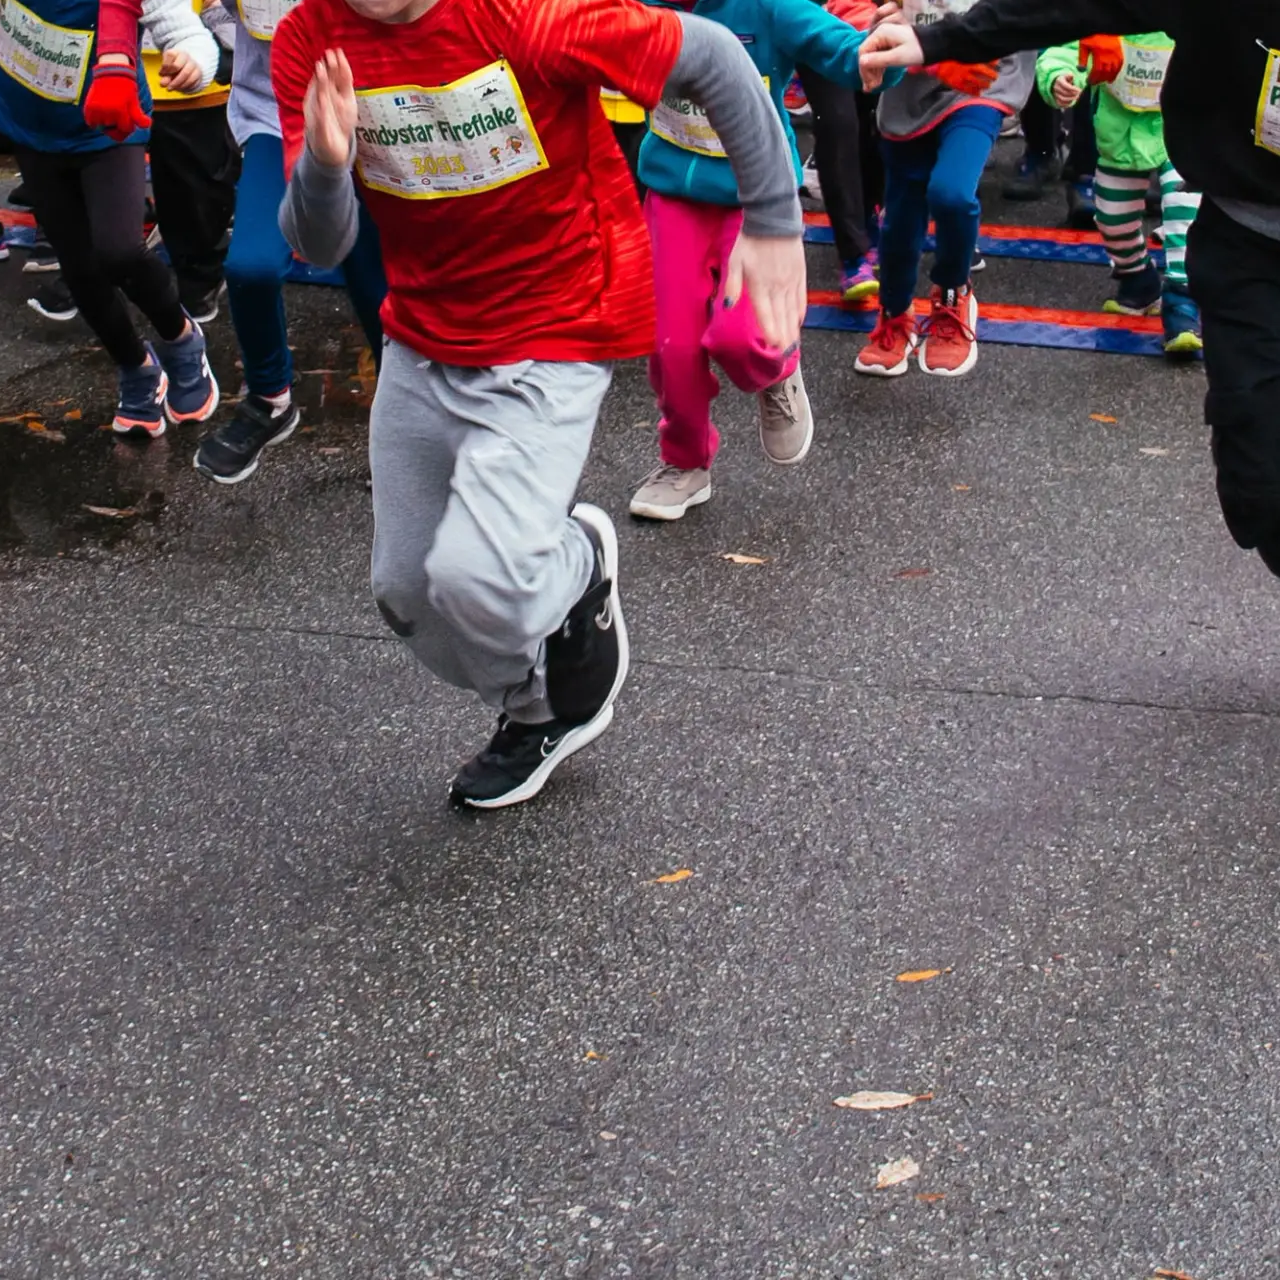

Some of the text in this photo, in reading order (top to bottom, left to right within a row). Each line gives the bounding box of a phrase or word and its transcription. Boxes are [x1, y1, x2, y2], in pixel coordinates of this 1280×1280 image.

[32, 41, 82, 69] Snowballs
[1126, 63, 1163, 81] Kevin
[355, 106, 518, 146] randystar Fireflake
